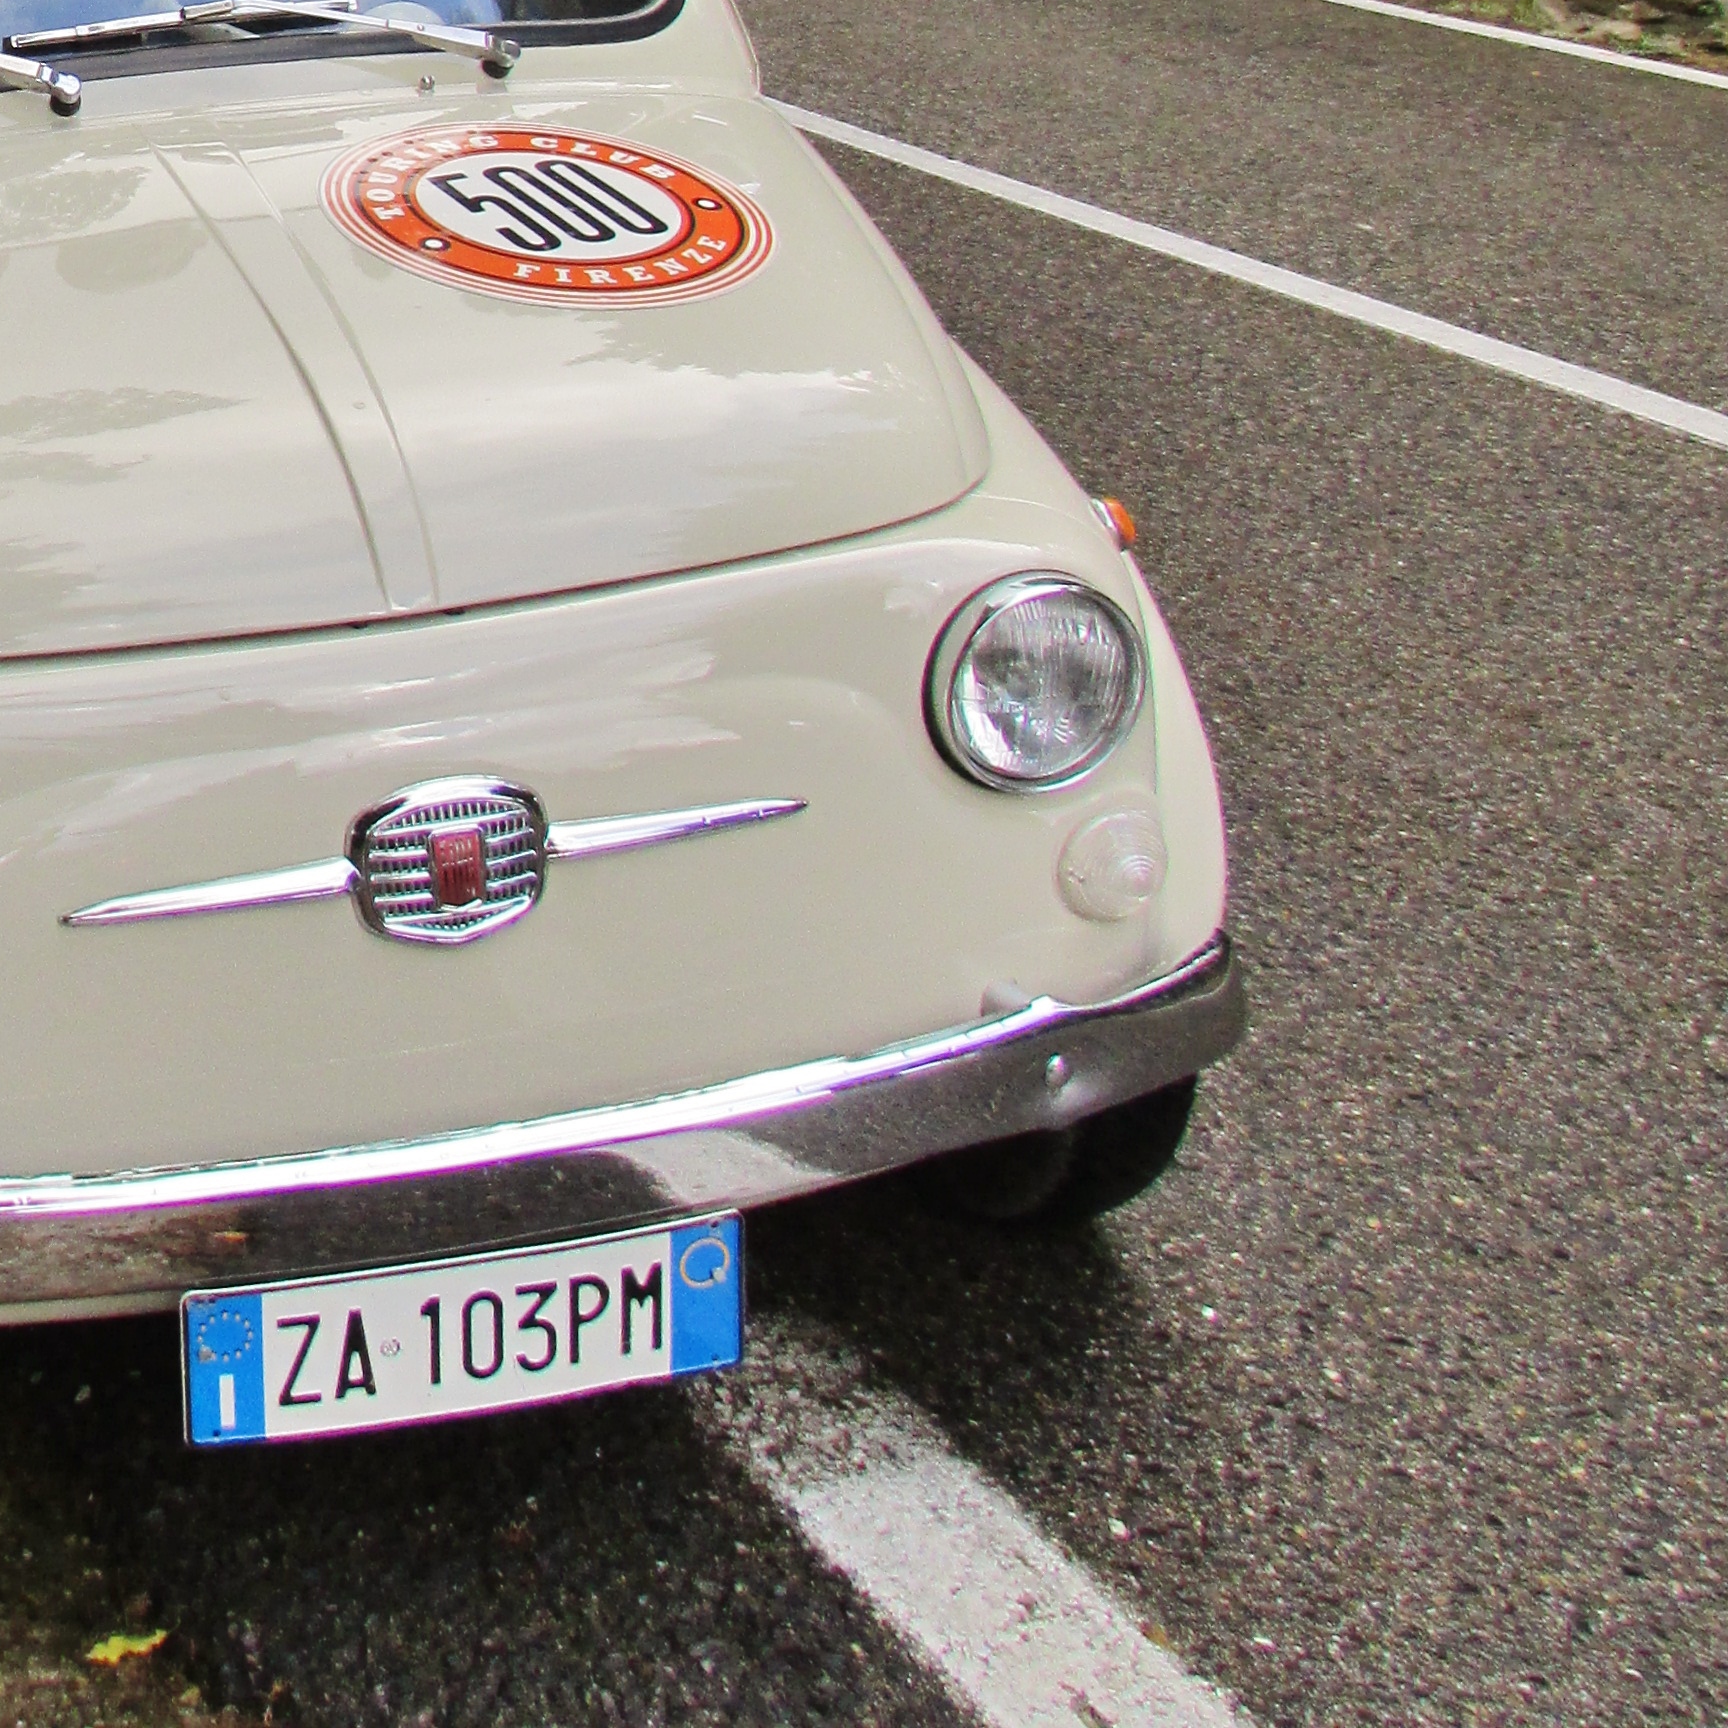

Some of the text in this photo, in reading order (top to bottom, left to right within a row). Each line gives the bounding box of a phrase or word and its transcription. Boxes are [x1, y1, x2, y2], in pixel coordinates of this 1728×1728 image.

[366, 135, 676, 220] TOURING CLUB
[425, 159, 669, 251] 500
[513, 235, 727, 284] FIRENZE
[277, 1261, 663, 1406] ZA 103PM
